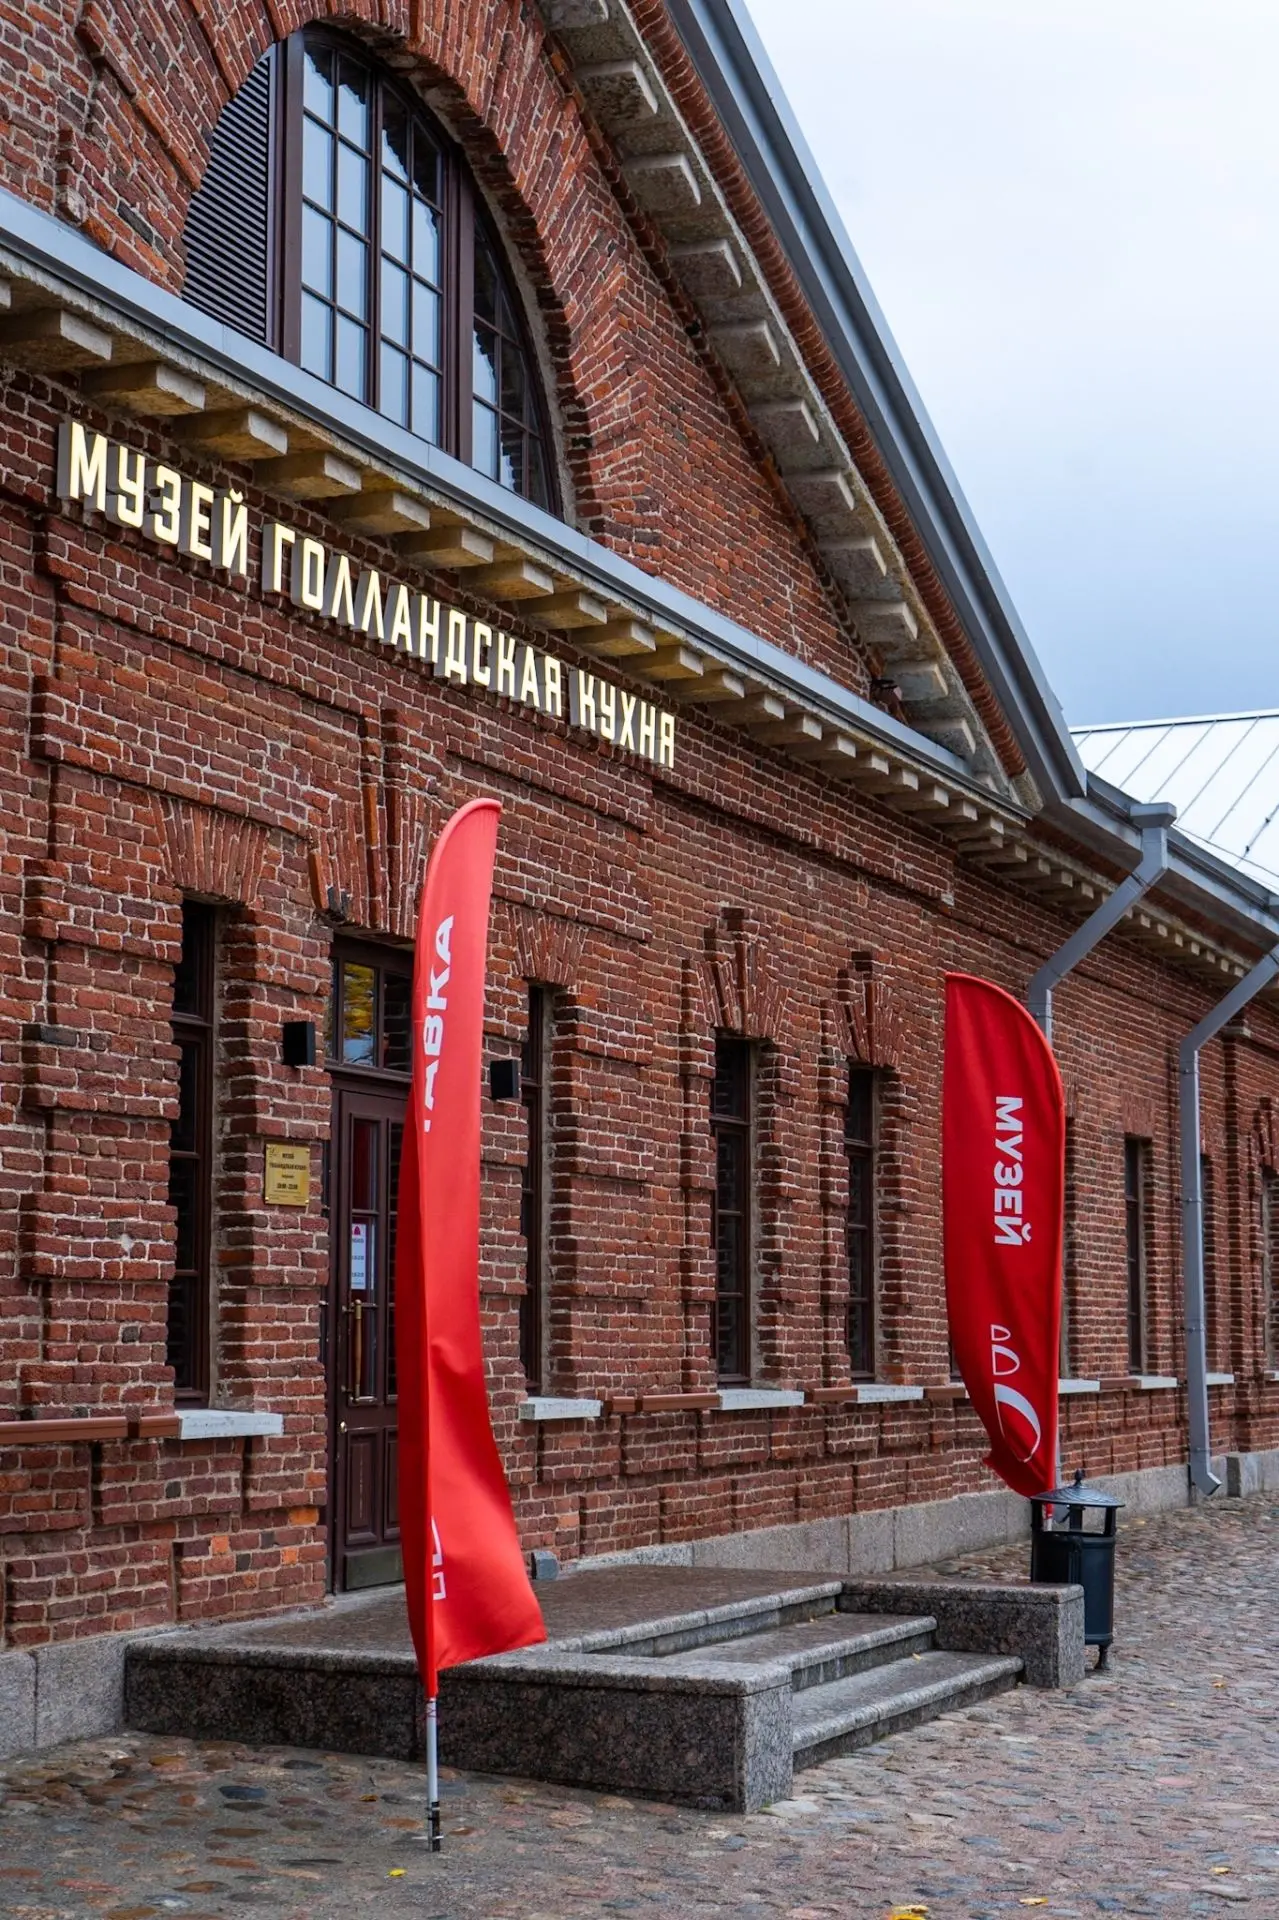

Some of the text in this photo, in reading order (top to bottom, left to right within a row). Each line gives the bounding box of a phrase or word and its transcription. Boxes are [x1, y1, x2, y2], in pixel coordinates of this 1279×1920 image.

[68, 420, 675, 769] МУЗЕЙ ГОЛЛАНДСКАЯ КУХНЯ
[423, 914, 455, 1133] АВКА
[993, 1096, 1031, 1245] МУЗЕЙ
